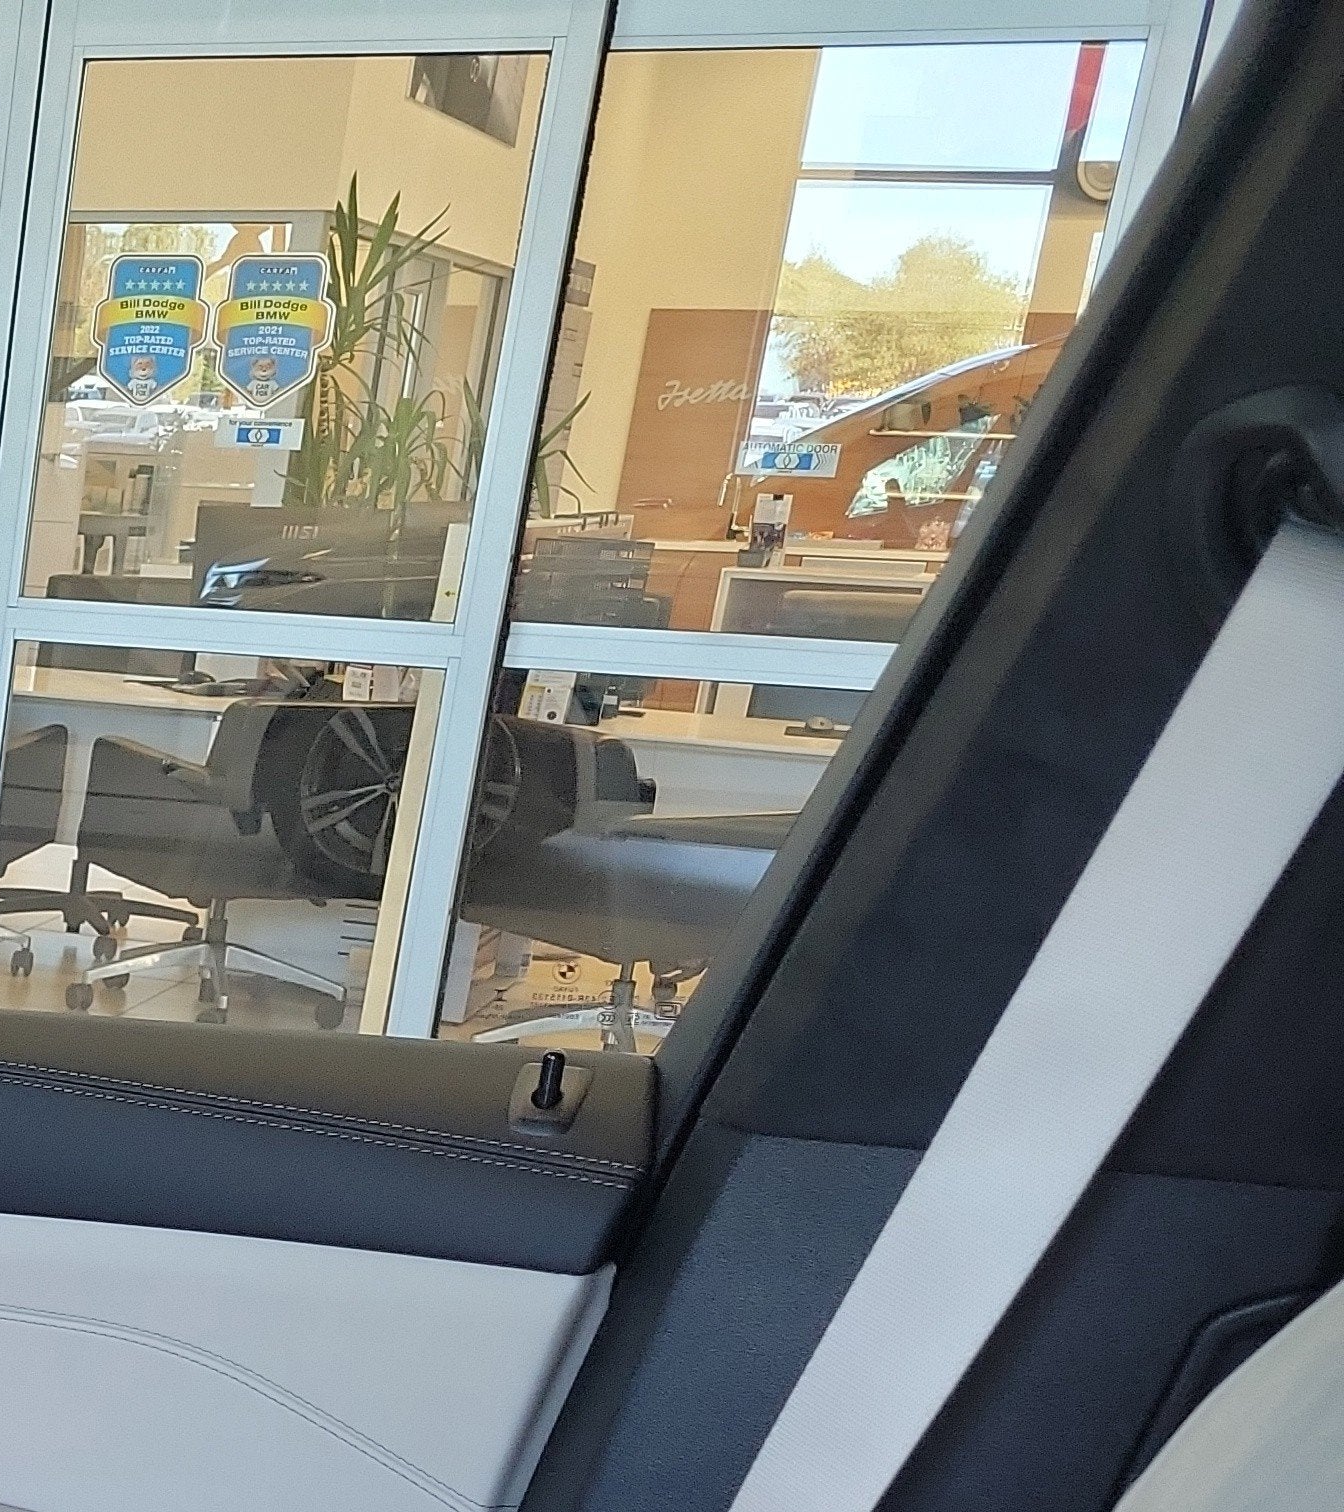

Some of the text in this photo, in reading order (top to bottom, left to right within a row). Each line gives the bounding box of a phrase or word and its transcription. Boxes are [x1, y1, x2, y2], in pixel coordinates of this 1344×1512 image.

[119, 298, 185, 311] Bill Dodge
[240, 299, 308, 312] Bill Dodge
[135, 310, 169, 319] BMW
[255, 311, 290, 320] BMW
[259, 326, 283, 335] 2021
[124, 336, 173, 345] TOP-RATED
[243, 337, 296, 346] TOP-RATED
[109, 345, 185, 357] SERVICE CENTER
[228, 347, 308, 358] SERVICE CENTER
[743, 442, 838, 454] AUTOMATIC DOOR
